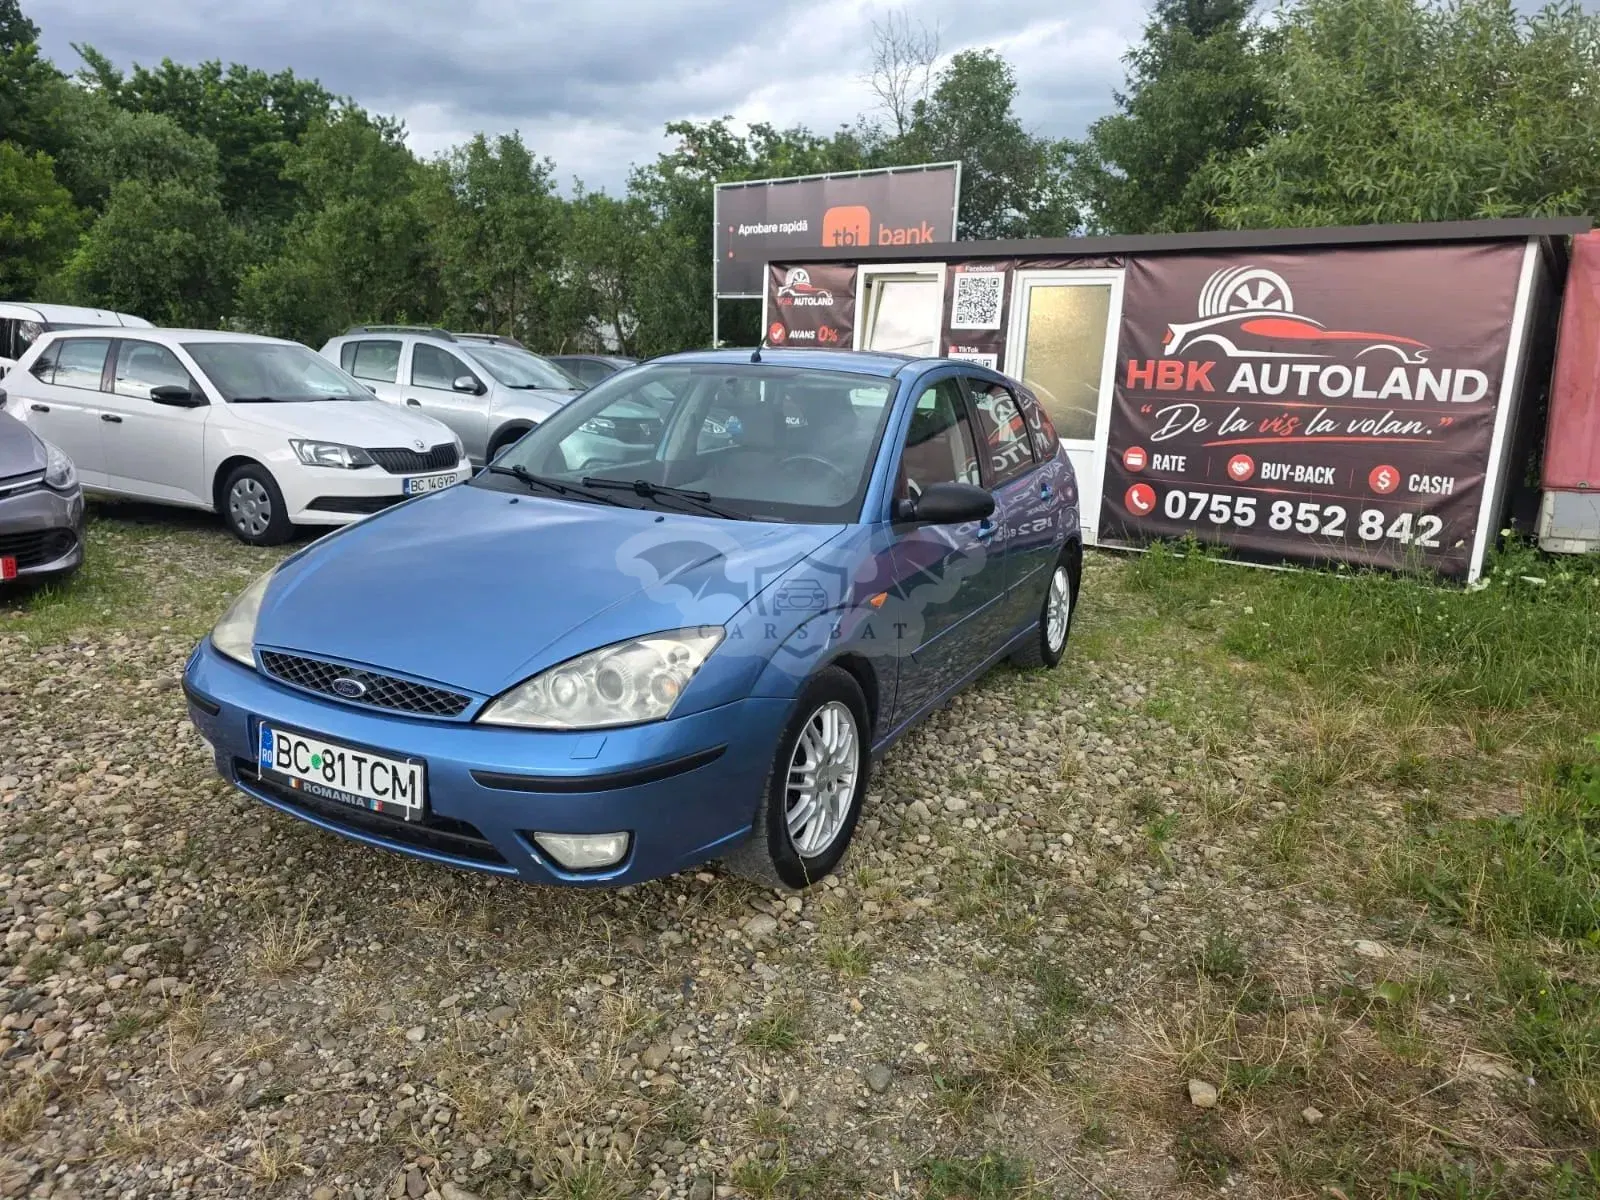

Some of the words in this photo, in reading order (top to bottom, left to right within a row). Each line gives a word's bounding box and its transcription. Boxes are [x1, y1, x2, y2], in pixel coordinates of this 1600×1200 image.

[738, 222, 778, 235] Aprobare
[779, 219, 808, 233] rapidă
[878, 220, 934, 245] bank
[794, 297, 834, 306] AUTOLAND
[789, 329, 816, 339] AVANS
[818, 325, 838, 342] 0%
[958, 345, 979, 353] TikTok
[1126, 359, 1217, 393] HBK
[1226, 362, 1488, 403] AUTOLAND
[1217, 406, 1254, 436] la
[1258, 412, 1302, 436] vis
[1304, 407, 1340, 436] la
[1152, 453, 1187, 472] RATE
[1261, 462, 1336, 485] BUY-BACK
[1408, 473, 1455, 495] CASH
[1164, 489, 1257, 528] 0755
[1270, 500, 1347, 537] 852
[1357, 508, 1443, 548] 842
[262, 748, 272, 763] RO
[303, 782, 366, 808] ROMANIA
